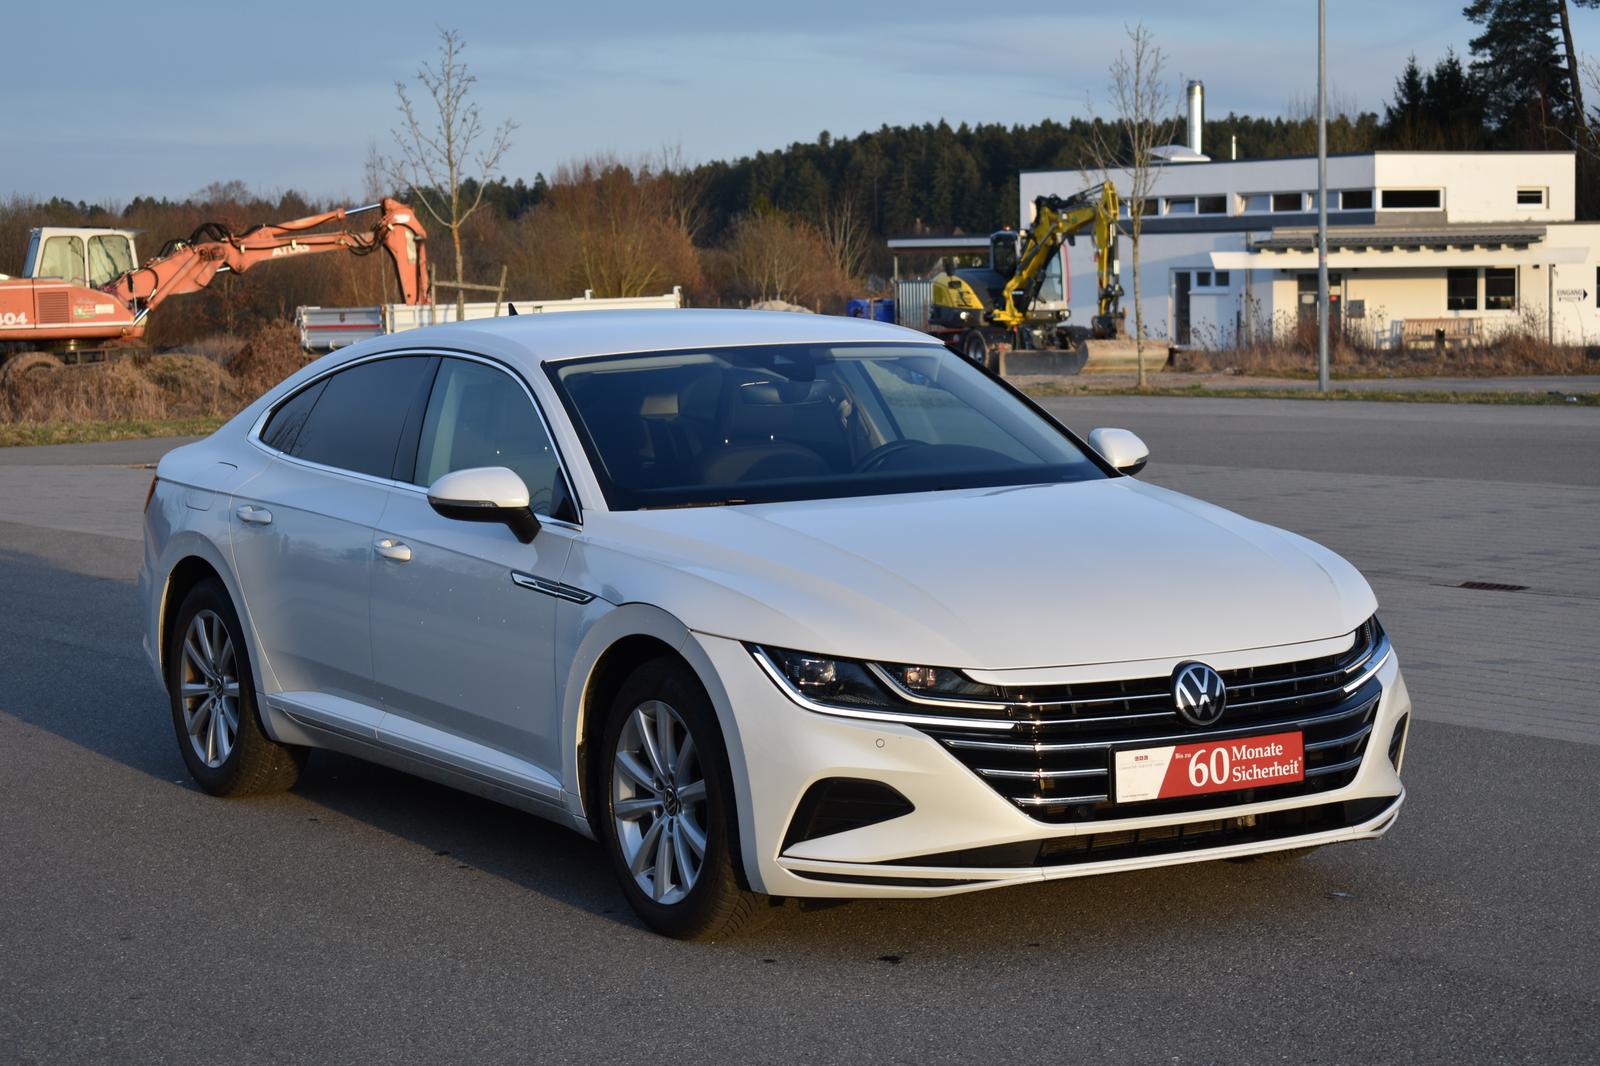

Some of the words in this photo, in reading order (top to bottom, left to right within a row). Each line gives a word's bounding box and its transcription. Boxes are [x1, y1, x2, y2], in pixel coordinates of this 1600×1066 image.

[272, 244, 310, 257] ATLAS
[1556, 288, 1584, 297] EINGANG
[1231, 742, 1284, 762] Monate
[1188, 747, 1230, 788] 60
